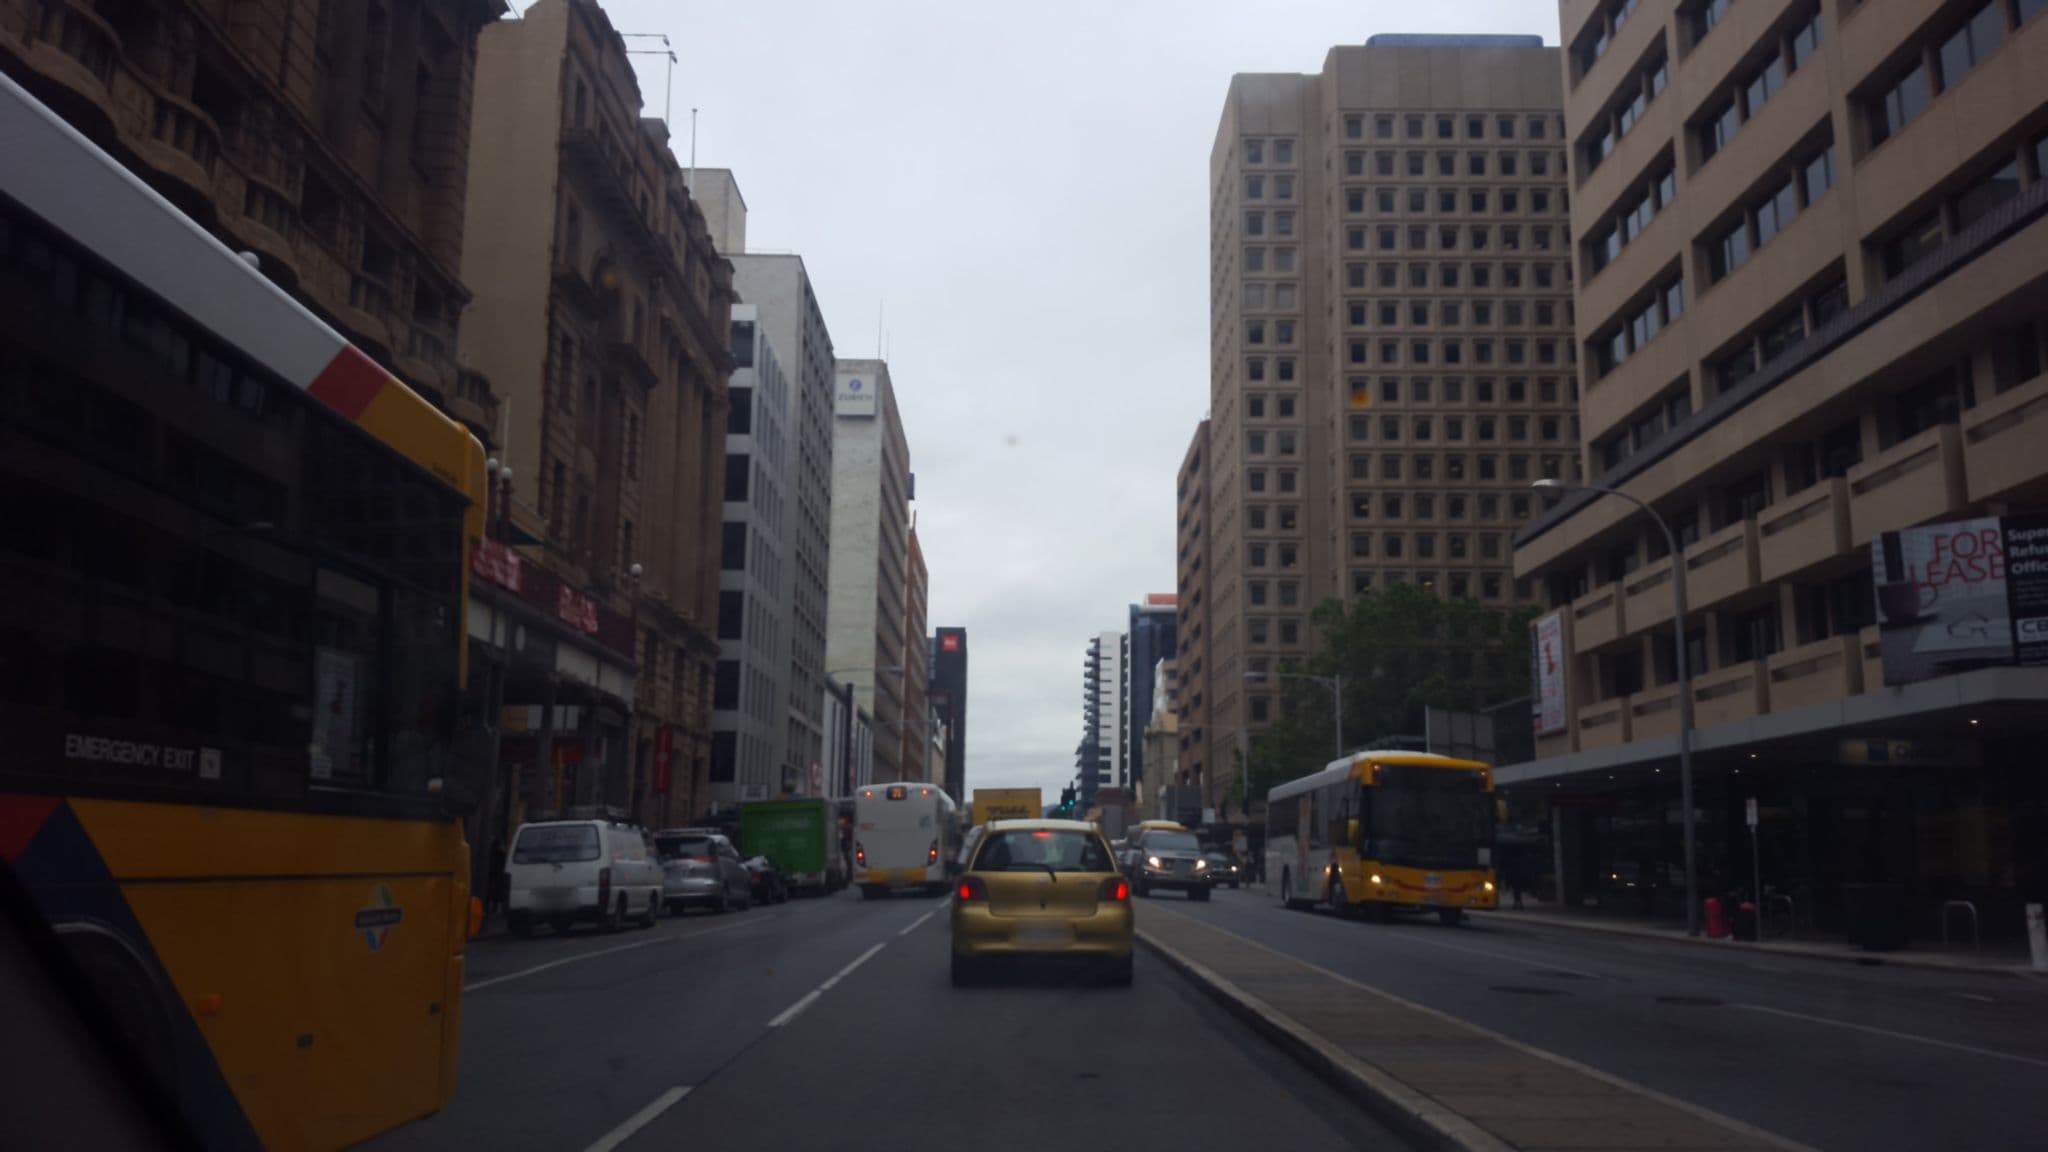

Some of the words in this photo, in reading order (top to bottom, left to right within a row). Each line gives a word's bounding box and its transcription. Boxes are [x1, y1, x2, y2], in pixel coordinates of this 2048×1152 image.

[1934, 528, 2005, 564] FOR
[1908, 556, 2006, 592] LEASE
[65, 733, 160, 767] EMERGENCY
[163, 747, 195, 769] EXIT
